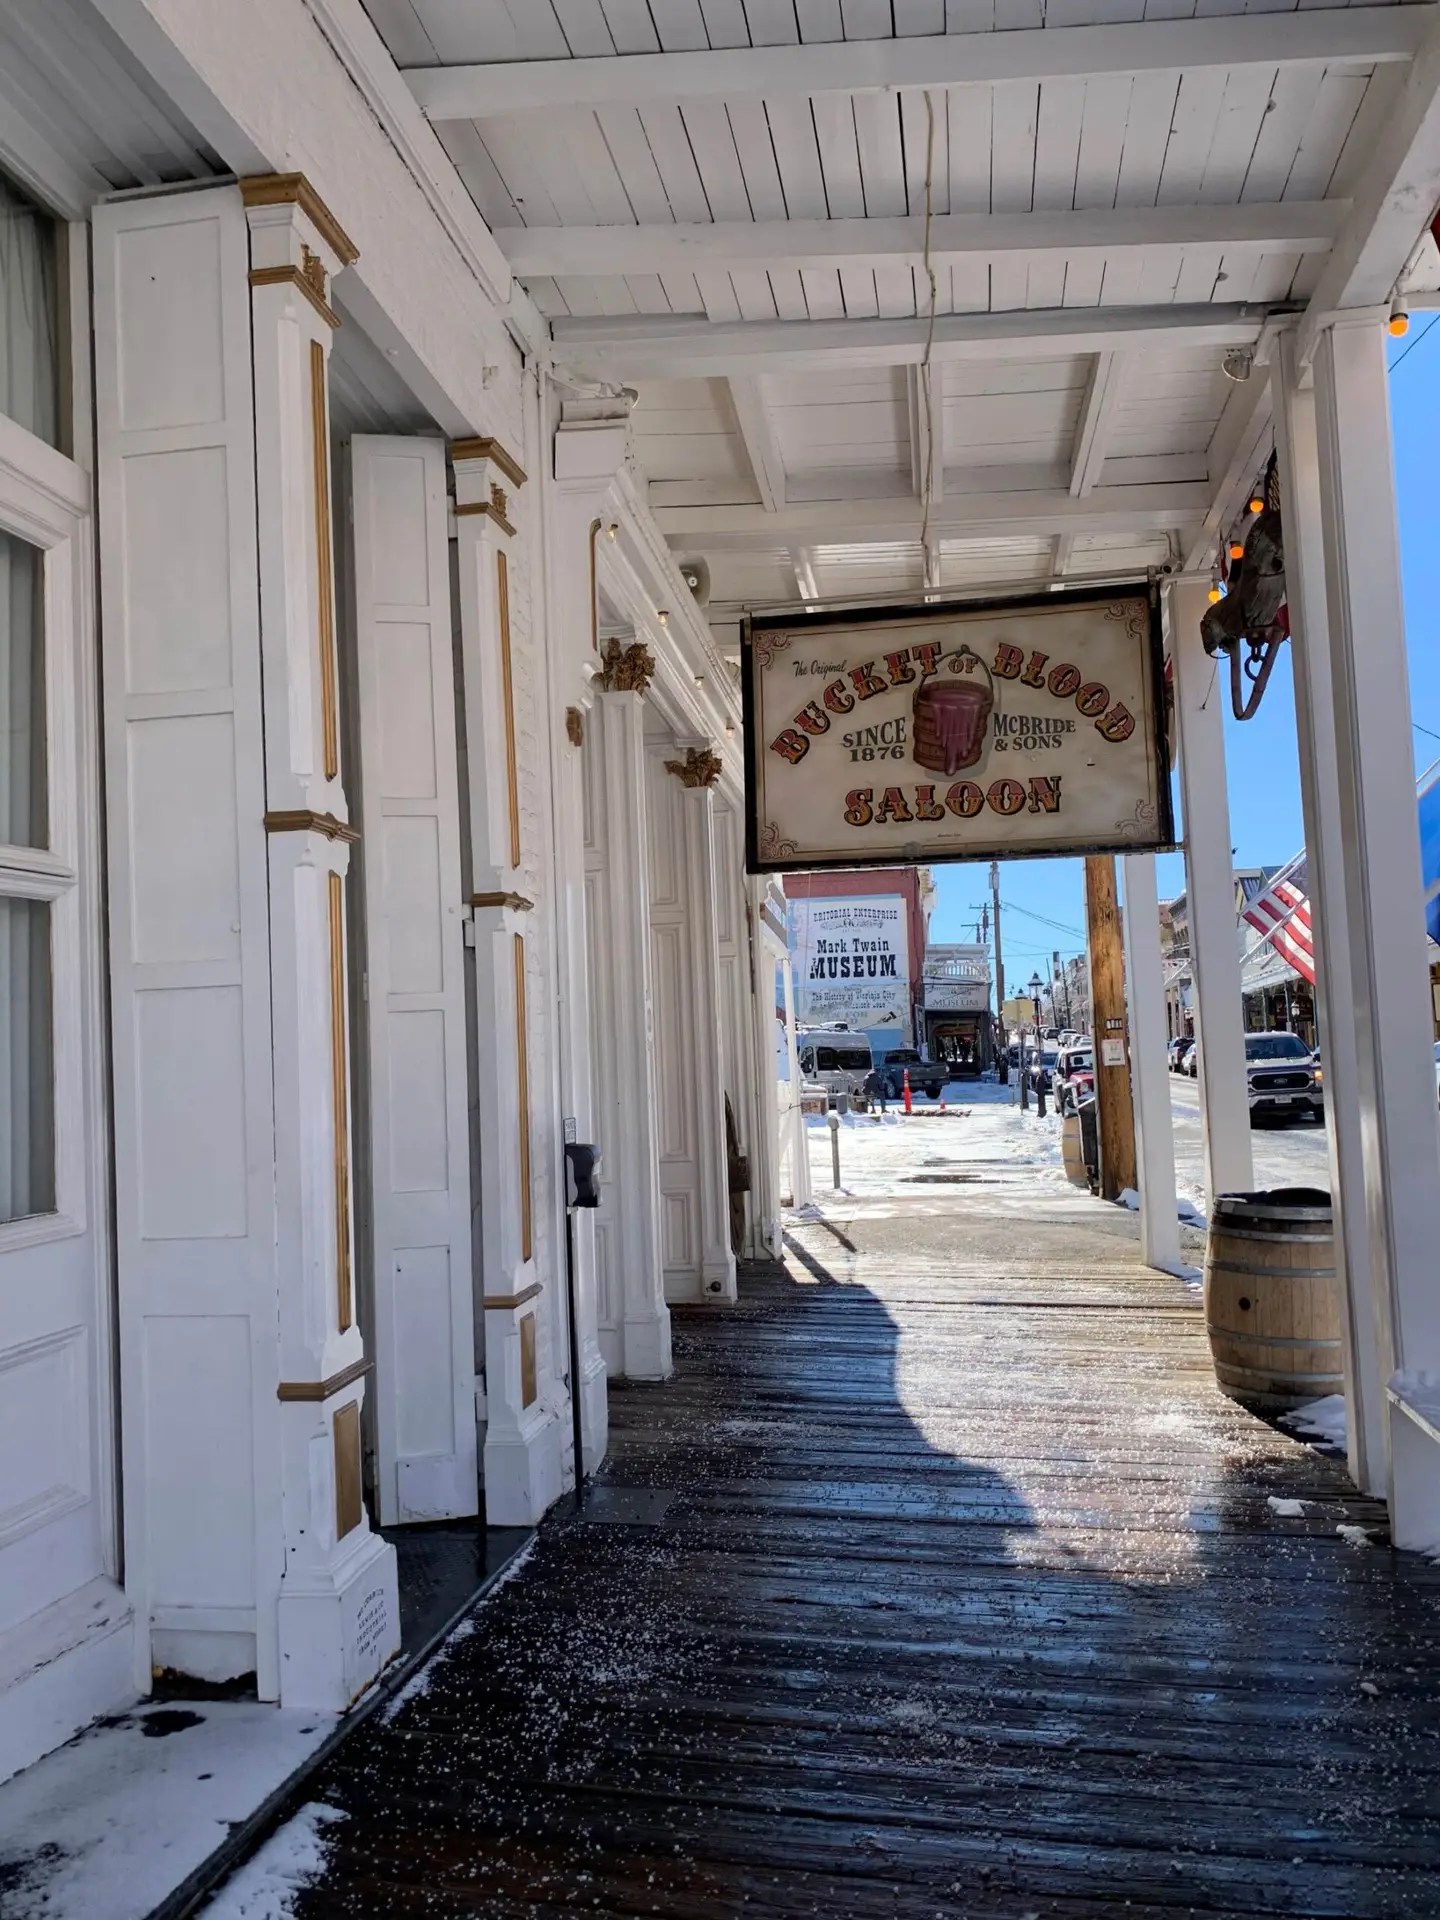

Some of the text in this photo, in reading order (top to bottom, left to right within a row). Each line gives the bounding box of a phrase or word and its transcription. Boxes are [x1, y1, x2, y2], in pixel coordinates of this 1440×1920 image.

[792, 659, 847, 680] The Original
[769, 641, 1136, 765] BUCKET OF BLOOD
[842, 716, 907, 748] SINCE
[994, 735, 1062, 752] & SONS
[849, 745, 905, 762] 1876
[844, 775, 1061, 827] SALOON
[854, 907, 898, 920] ENTERPRISE
[817, 936, 889, 954] Mark Twain
[810, 953, 896, 979] MUSEUM
[883, 990, 896, 1001] City
